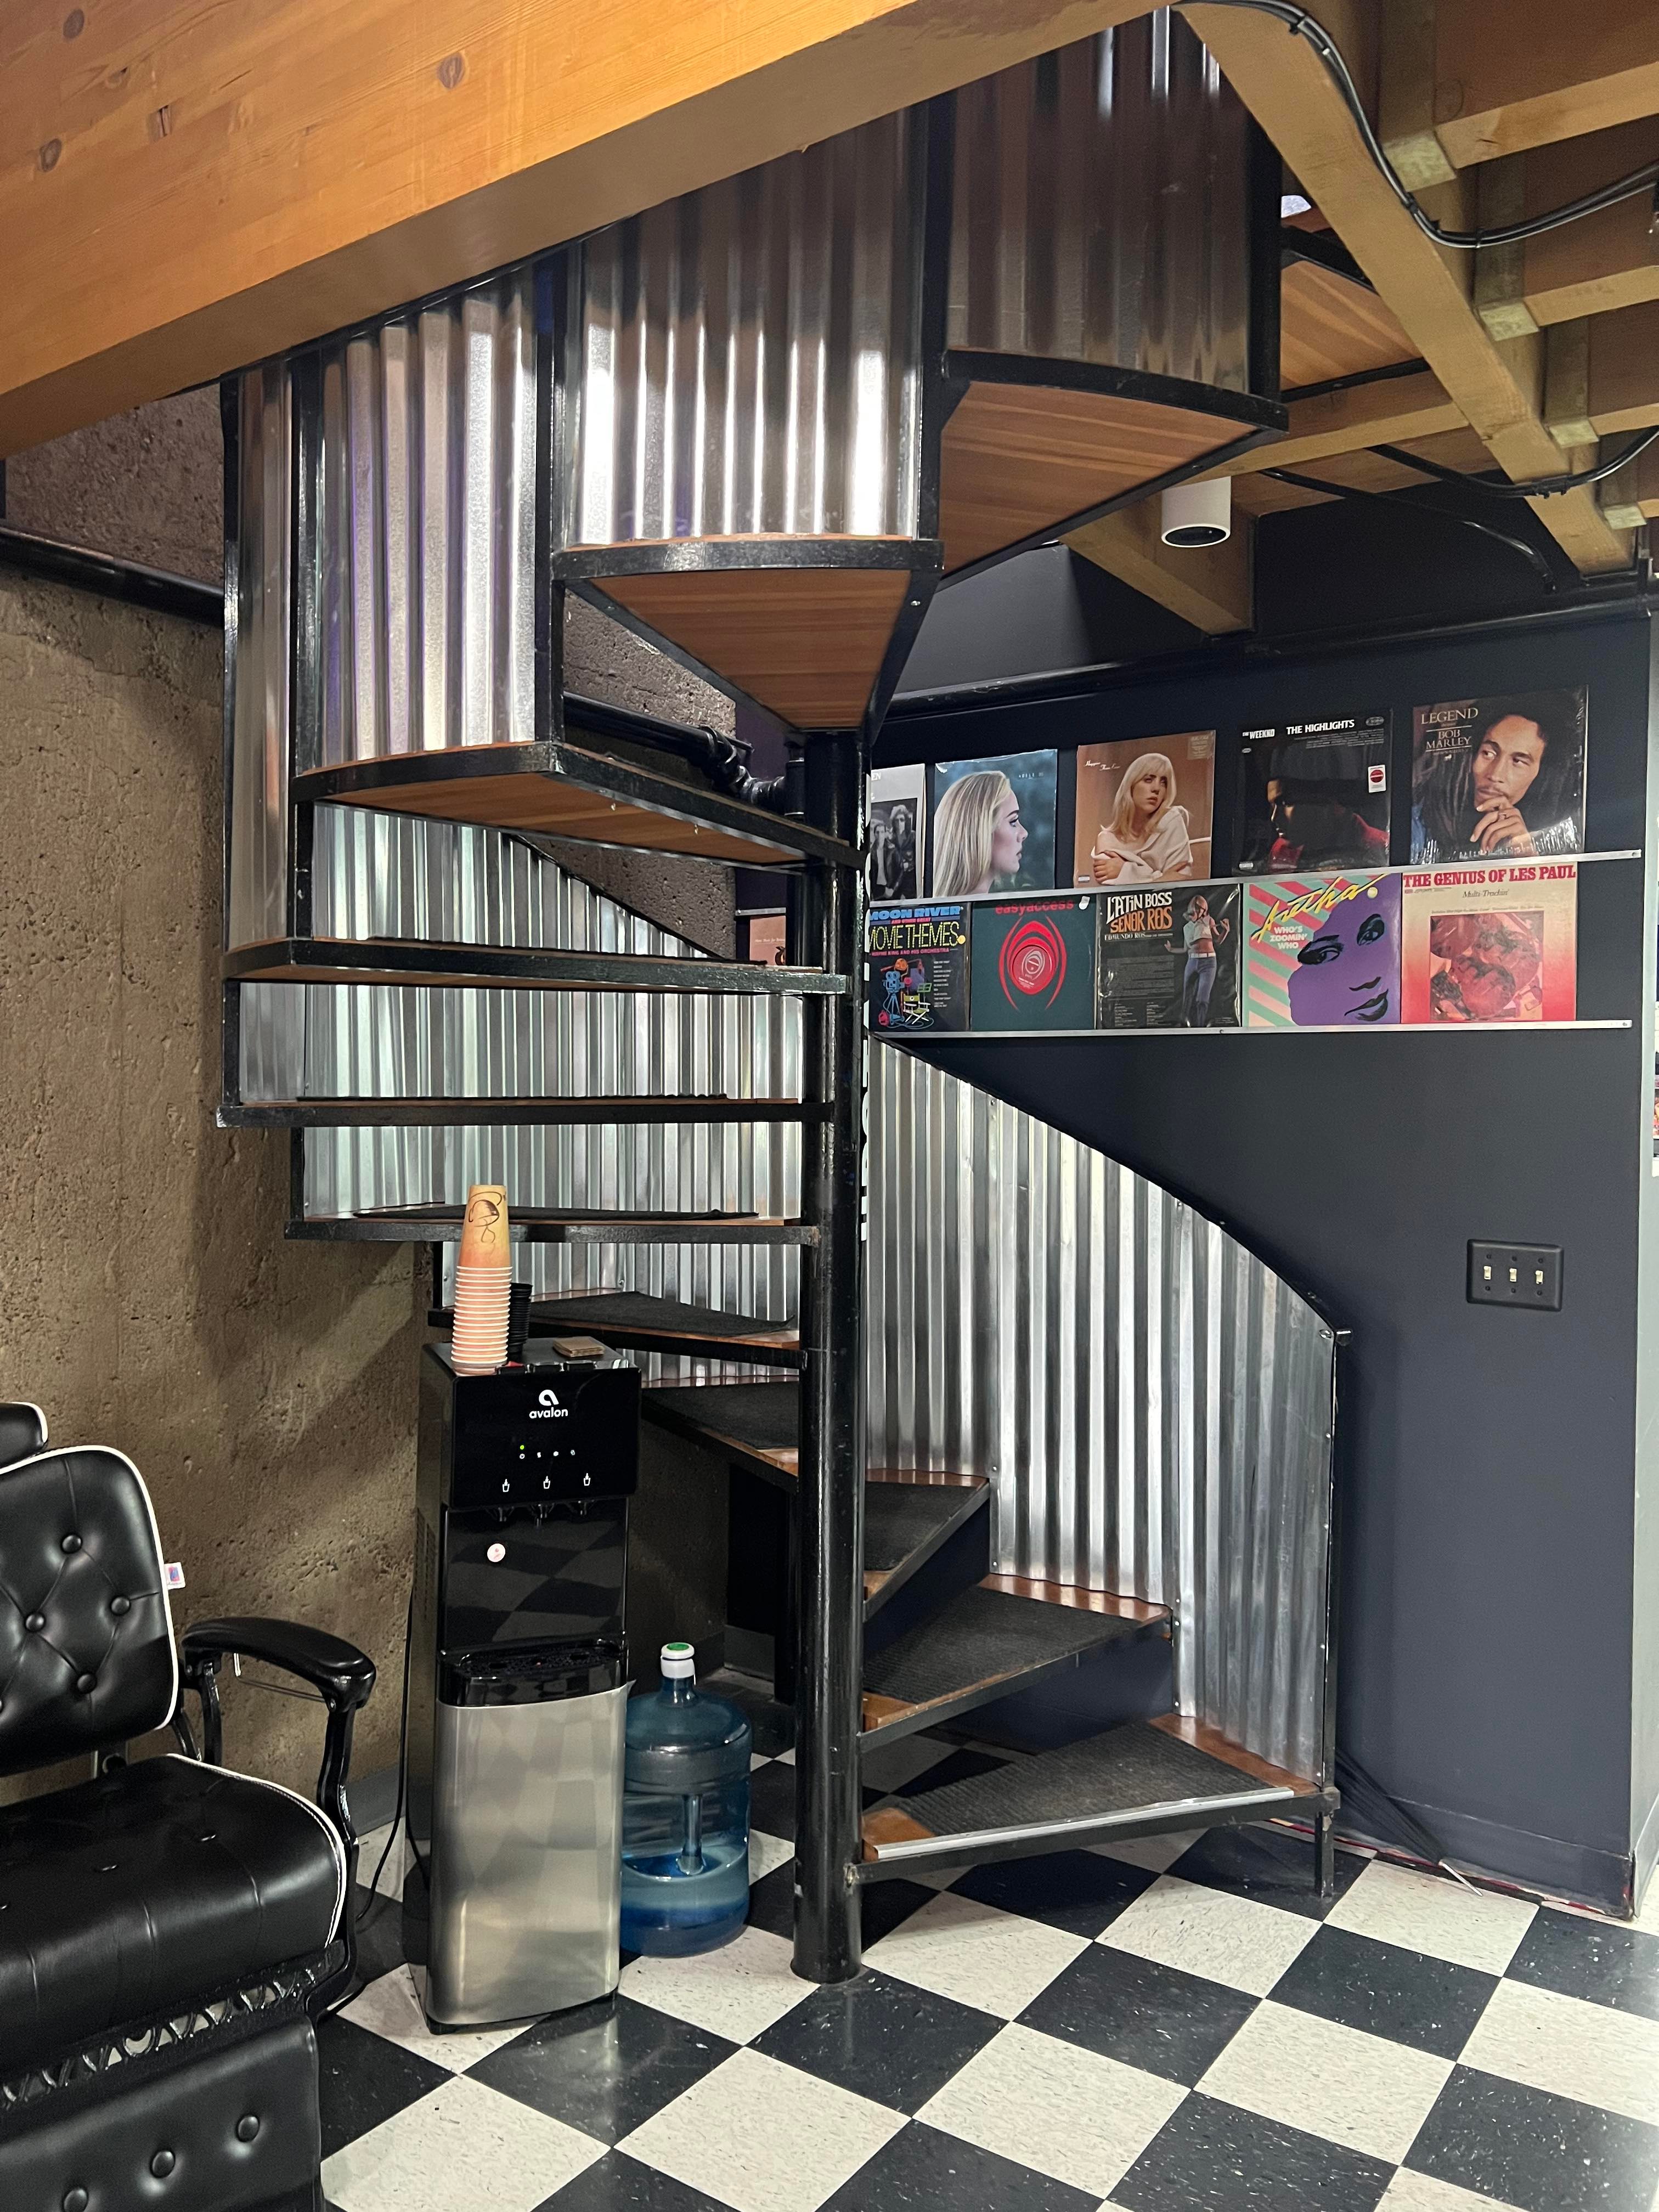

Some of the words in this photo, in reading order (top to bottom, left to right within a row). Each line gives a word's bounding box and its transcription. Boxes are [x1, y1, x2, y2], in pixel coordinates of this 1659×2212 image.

[1421, 708, 1479, 724] LEGEND
[1286, 726, 1303, 735] THE
[1305, 719, 1355, 733] HIGHLIGHTS
[1438, 730, 1460, 739] BOB
[1426, 736, 1472, 749] MARLEY
[1403, 873, 1431, 888] THE
[1434, 870, 1485, 886] GENIUS
[1488, 869, 1507, 883] OF
[1509, 867, 1536, 882] LES
[1539, 865, 1576, 880] PAUL
[1144, 891, 1172, 908] BOSS
[870, 909, 912, 921] MOON
[914, 906, 961, 918] RIVER
[995, 900, 1074, 916] easyaccess
[905, 921, 960, 949] THEMES
[1269, 934, 1308, 942] ZOOMIN'
[1274, 926, 1303, 935] WHO'S
[529, 1407, 568, 1419] avalon
